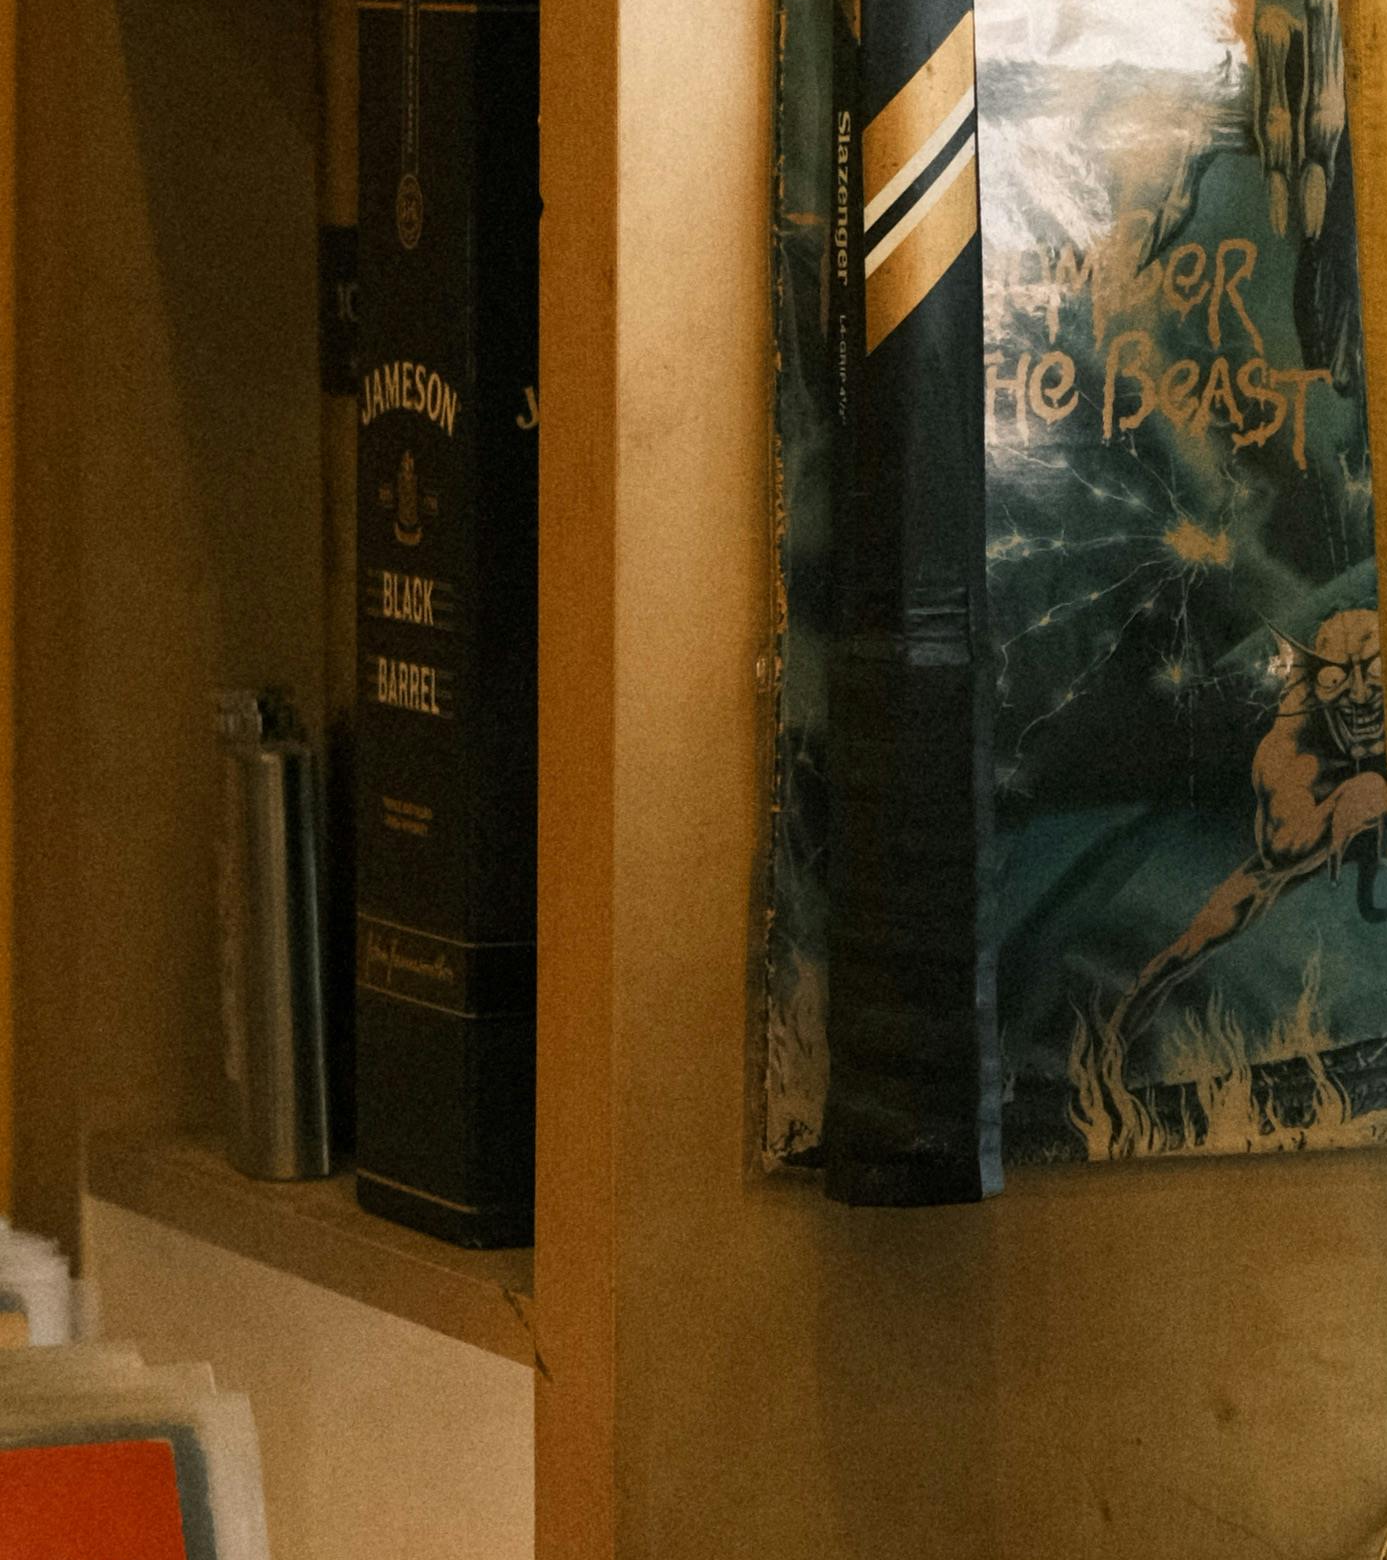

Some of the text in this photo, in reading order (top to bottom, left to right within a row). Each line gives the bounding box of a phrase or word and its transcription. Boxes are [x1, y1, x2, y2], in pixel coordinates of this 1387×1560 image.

[834, 110, 852, 286] Slazenger
[359, 360, 459, 437] JAMESON
[381, 570, 435, 626] BLACK
[376, 657, 441, 716] BARREL
